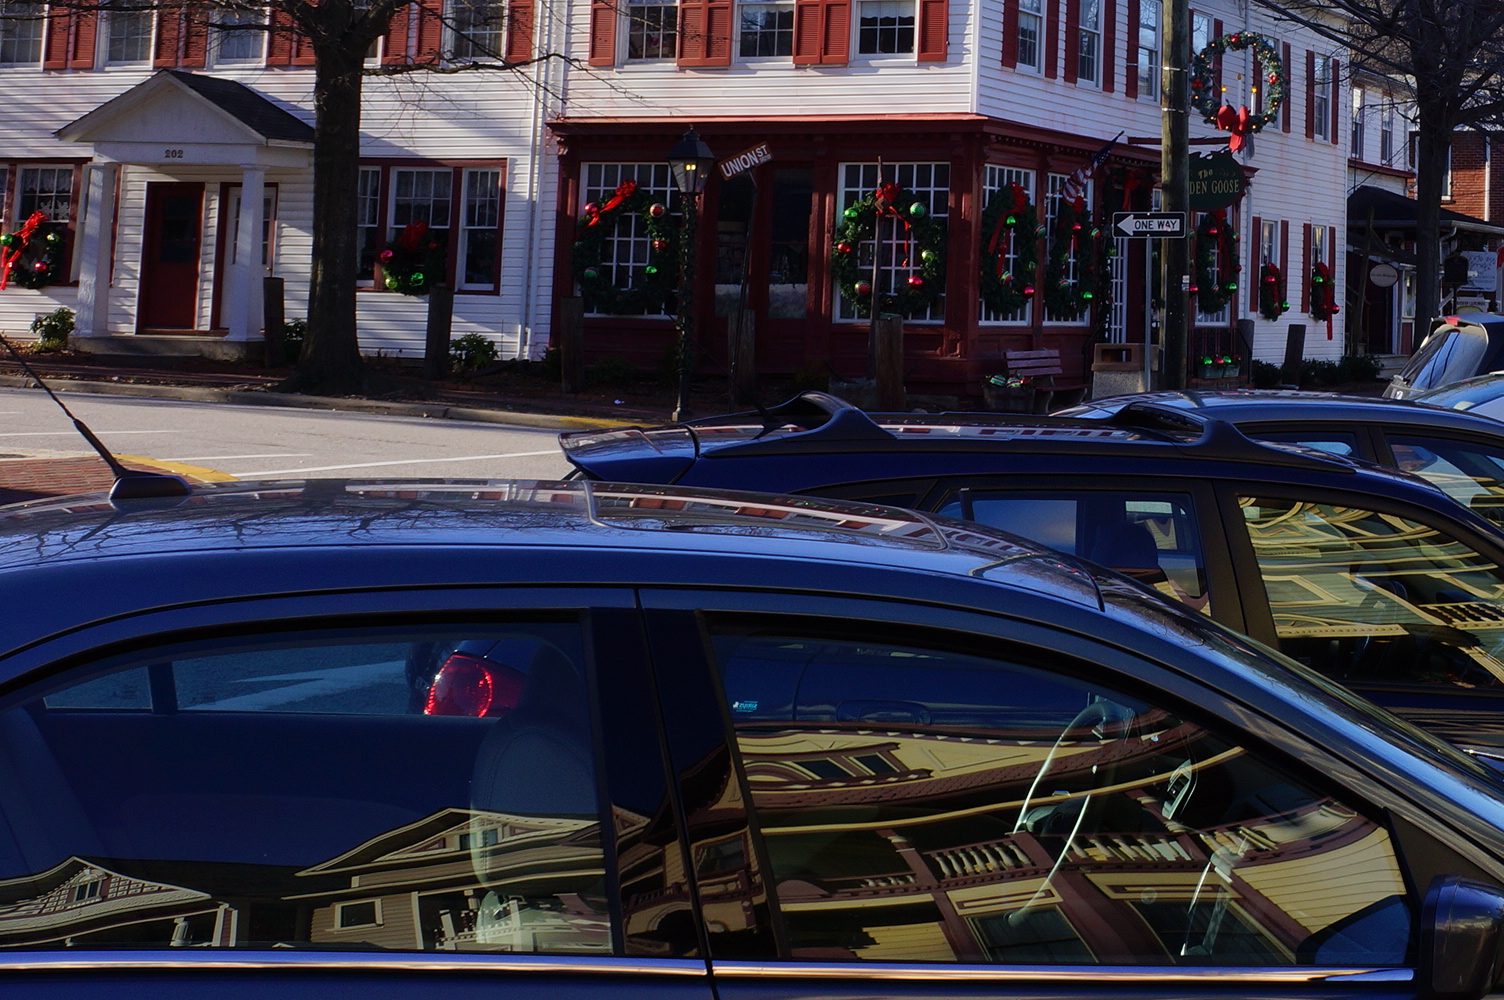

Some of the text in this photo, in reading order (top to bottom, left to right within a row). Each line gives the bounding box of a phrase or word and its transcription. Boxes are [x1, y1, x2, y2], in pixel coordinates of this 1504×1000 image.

[165, 149, 183, 158] 202
[721, 151, 759, 177] UNION
[756, 144, 768, 157] ST
[1198, 169, 1213, 180] The
[1189, 179, 1240, 195] DEN GOOSE
[1134, 220, 1177, 231] ONE WAY
